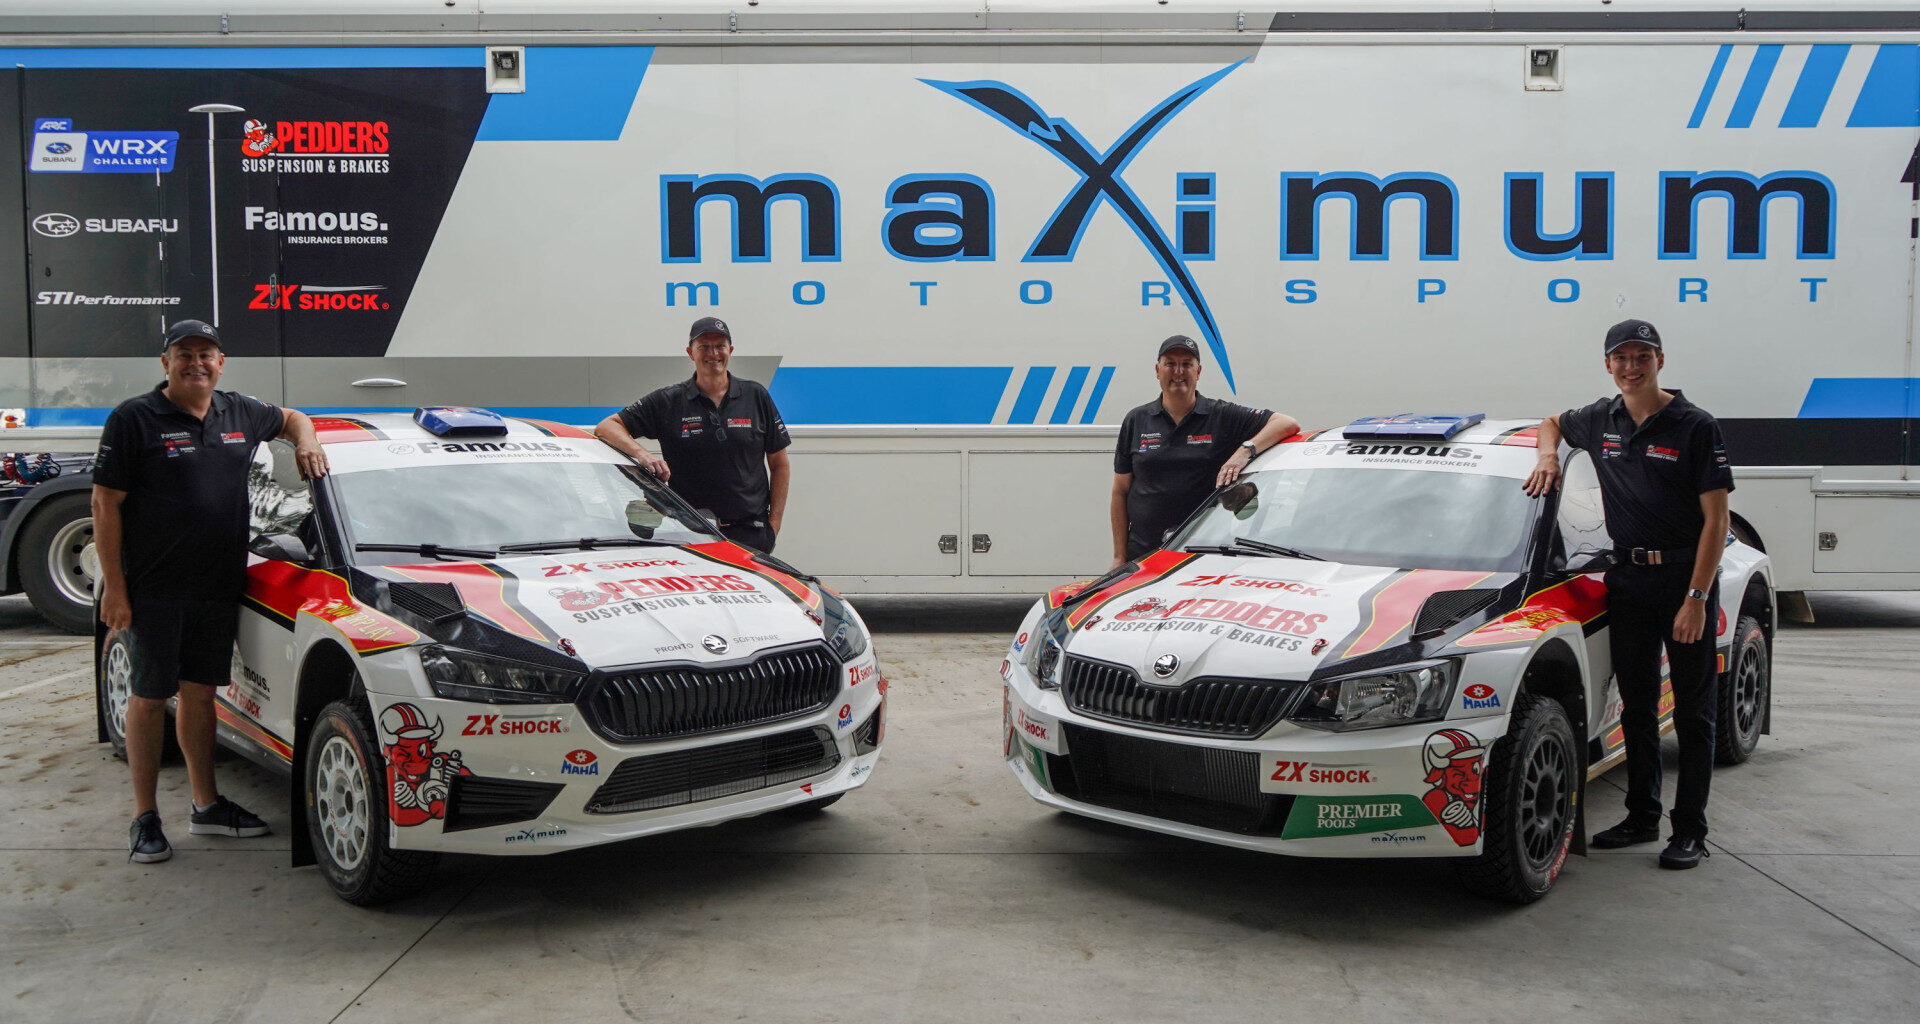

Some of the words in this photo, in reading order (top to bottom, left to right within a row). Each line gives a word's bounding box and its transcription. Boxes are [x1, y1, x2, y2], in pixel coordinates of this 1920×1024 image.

[276, 121, 390, 153] PEDDERS
[93, 139, 168, 155] WRX
[93, 157, 168, 165] CHALLENGE
[242, 159, 323, 173] SUSPENSION
[328, 159, 336, 173] &
[340, 159, 390, 173] BRAKES
[85, 218, 178, 233] SUBARU
[245, 206, 389, 231] Famous.
[288, 236, 342, 244] INSURANCE
[344, 236, 389, 244] BROKERS
[36, 292, 73, 305] STI
[74, 295, 181, 305] Performance
[249, 284, 299, 310] ZX
[417, 441, 574, 453] Famous.
[1326, 443, 1484, 460] Famous.
[1362, 457, 1425, 465] INSURANCE
[1425, 460, 1478, 468] BROKERS
[541, 562, 592, 577] ZX
[595, 575, 756, 600] PEDDERS
[1176, 574, 1238, 587] ZX
[572, 596, 692, 624] SUSPENSION
[693, 596, 706, 605] &
[708, 594, 773, 605] BRAKES
[1163, 598, 1328, 636] PEDDERS
[655, 643, 694, 654] PRONTO
[732, 634, 781, 644] SOFTWARE
[1102, 620, 1208, 632] SUSPENSION
[1210, 625, 1224, 636] &
[1226, 630, 1303, 652] BRAKES
[849, 665, 860, 687] ZX
[226, 680, 240, 702] ZX
[1463, 693, 1501, 710] MAHA
[461, 715, 499, 736] ZX
[837, 712, 852, 730] MAHA
[561, 759, 599, 775] MAHA
[1270, 761, 1309, 783] ZX
[1317, 803, 1403, 820] PREMIER
[1318, 819, 1356, 829] POOLS
